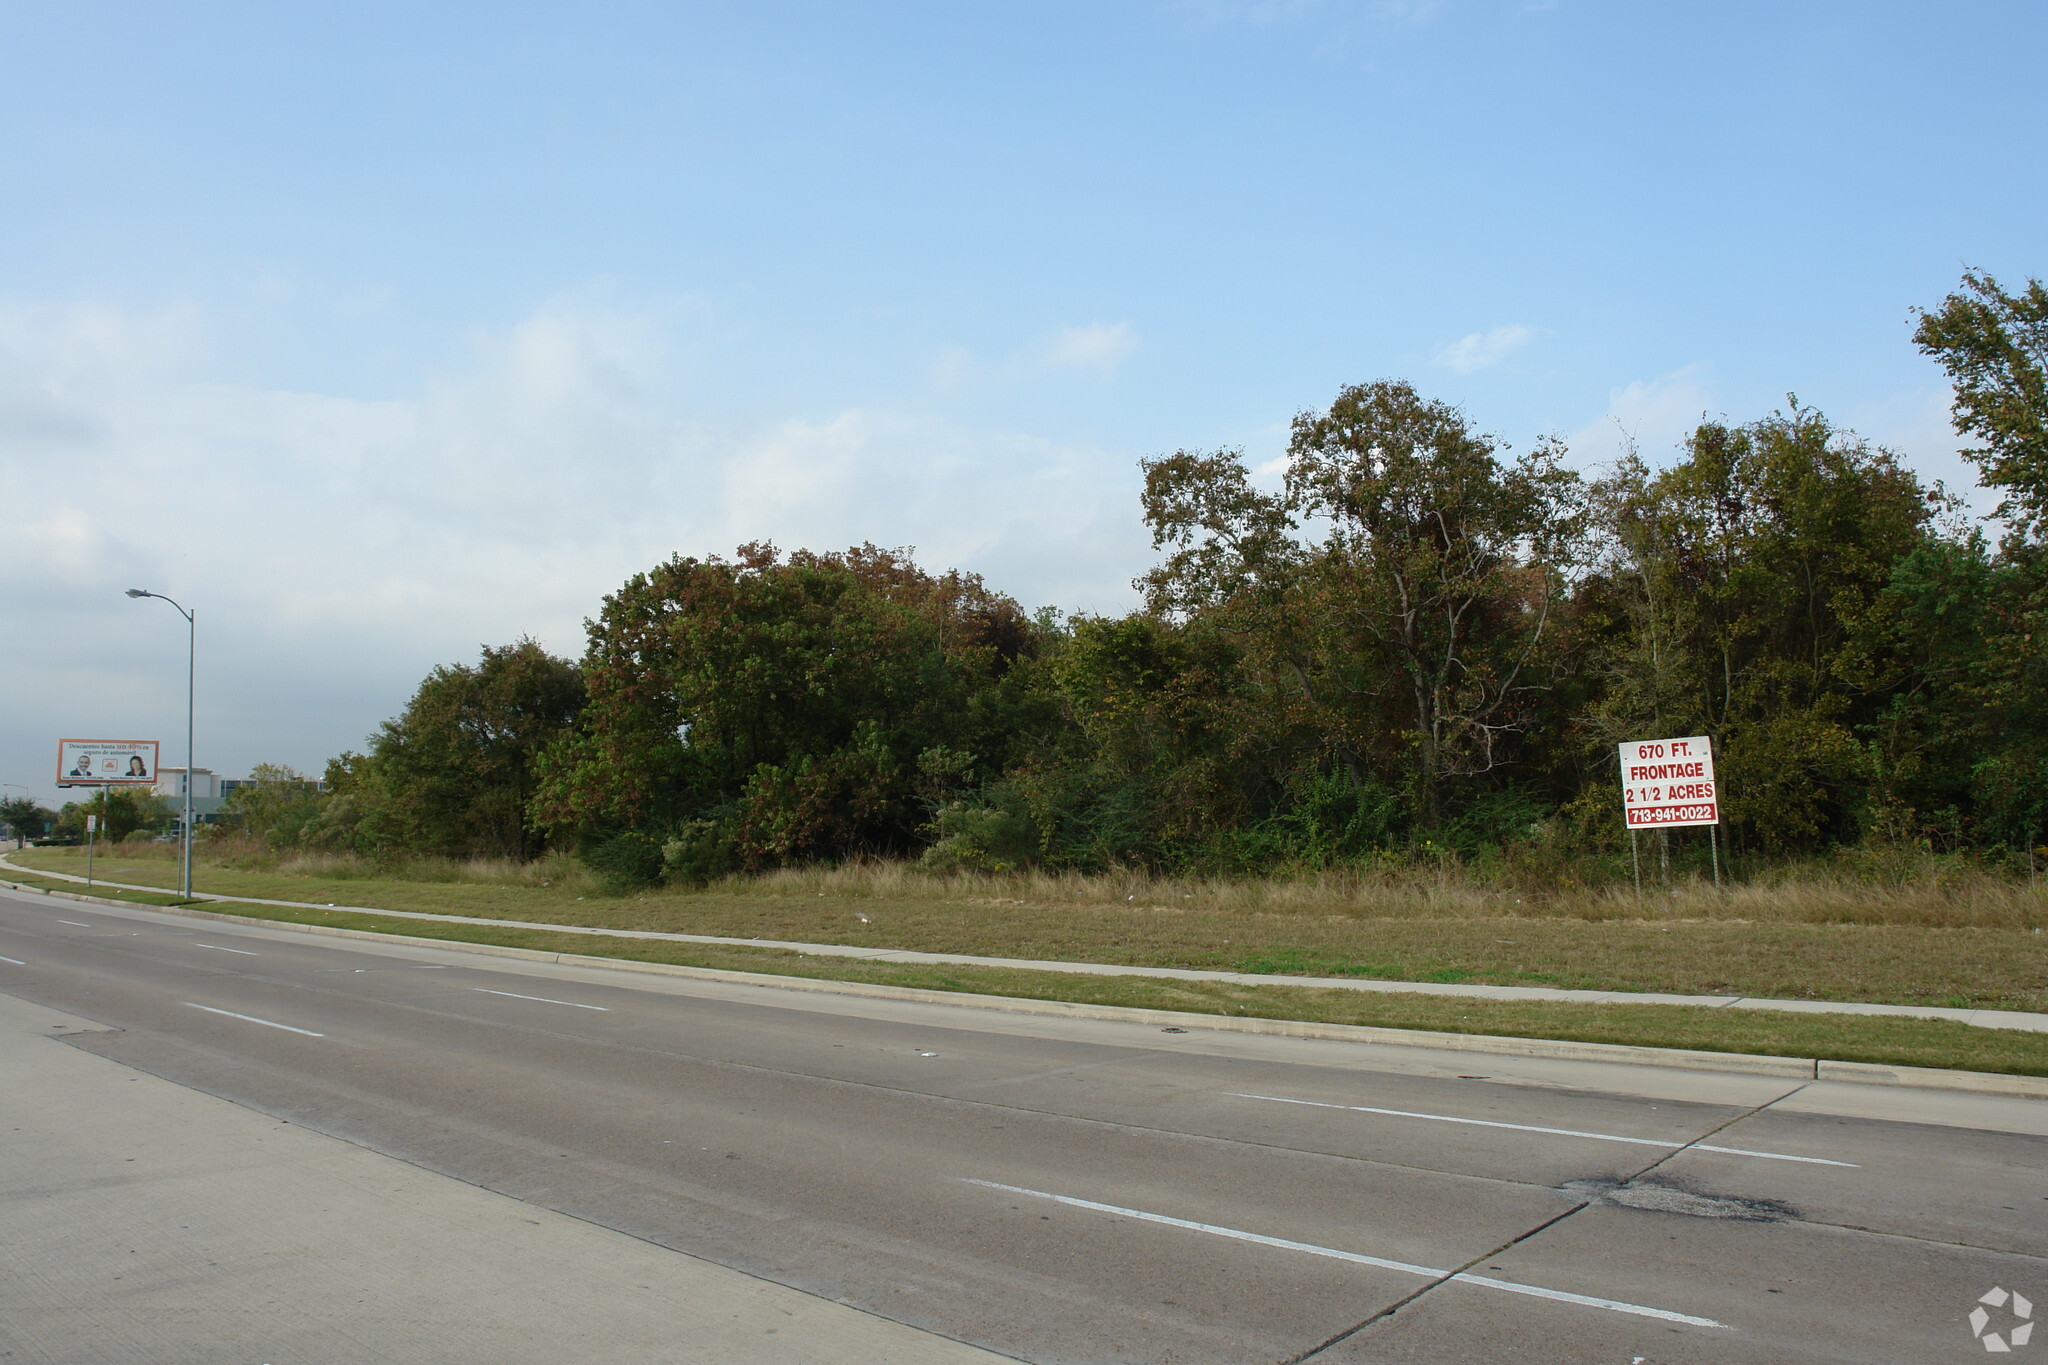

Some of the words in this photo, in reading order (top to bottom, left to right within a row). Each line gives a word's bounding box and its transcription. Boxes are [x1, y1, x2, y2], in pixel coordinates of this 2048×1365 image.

[1638, 744, 1664, 759] 670
[1671, 742, 1692, 757] FT.
[1630, 762, 1704, 781] FRONTAGE
[1626, 789, 1634, 803] 2
[1640, 787, 1661, 802] 1/2
[1668, 783, 1713, 800] ACRES
[1631, 805, 1712, 822] 713-941-0022
